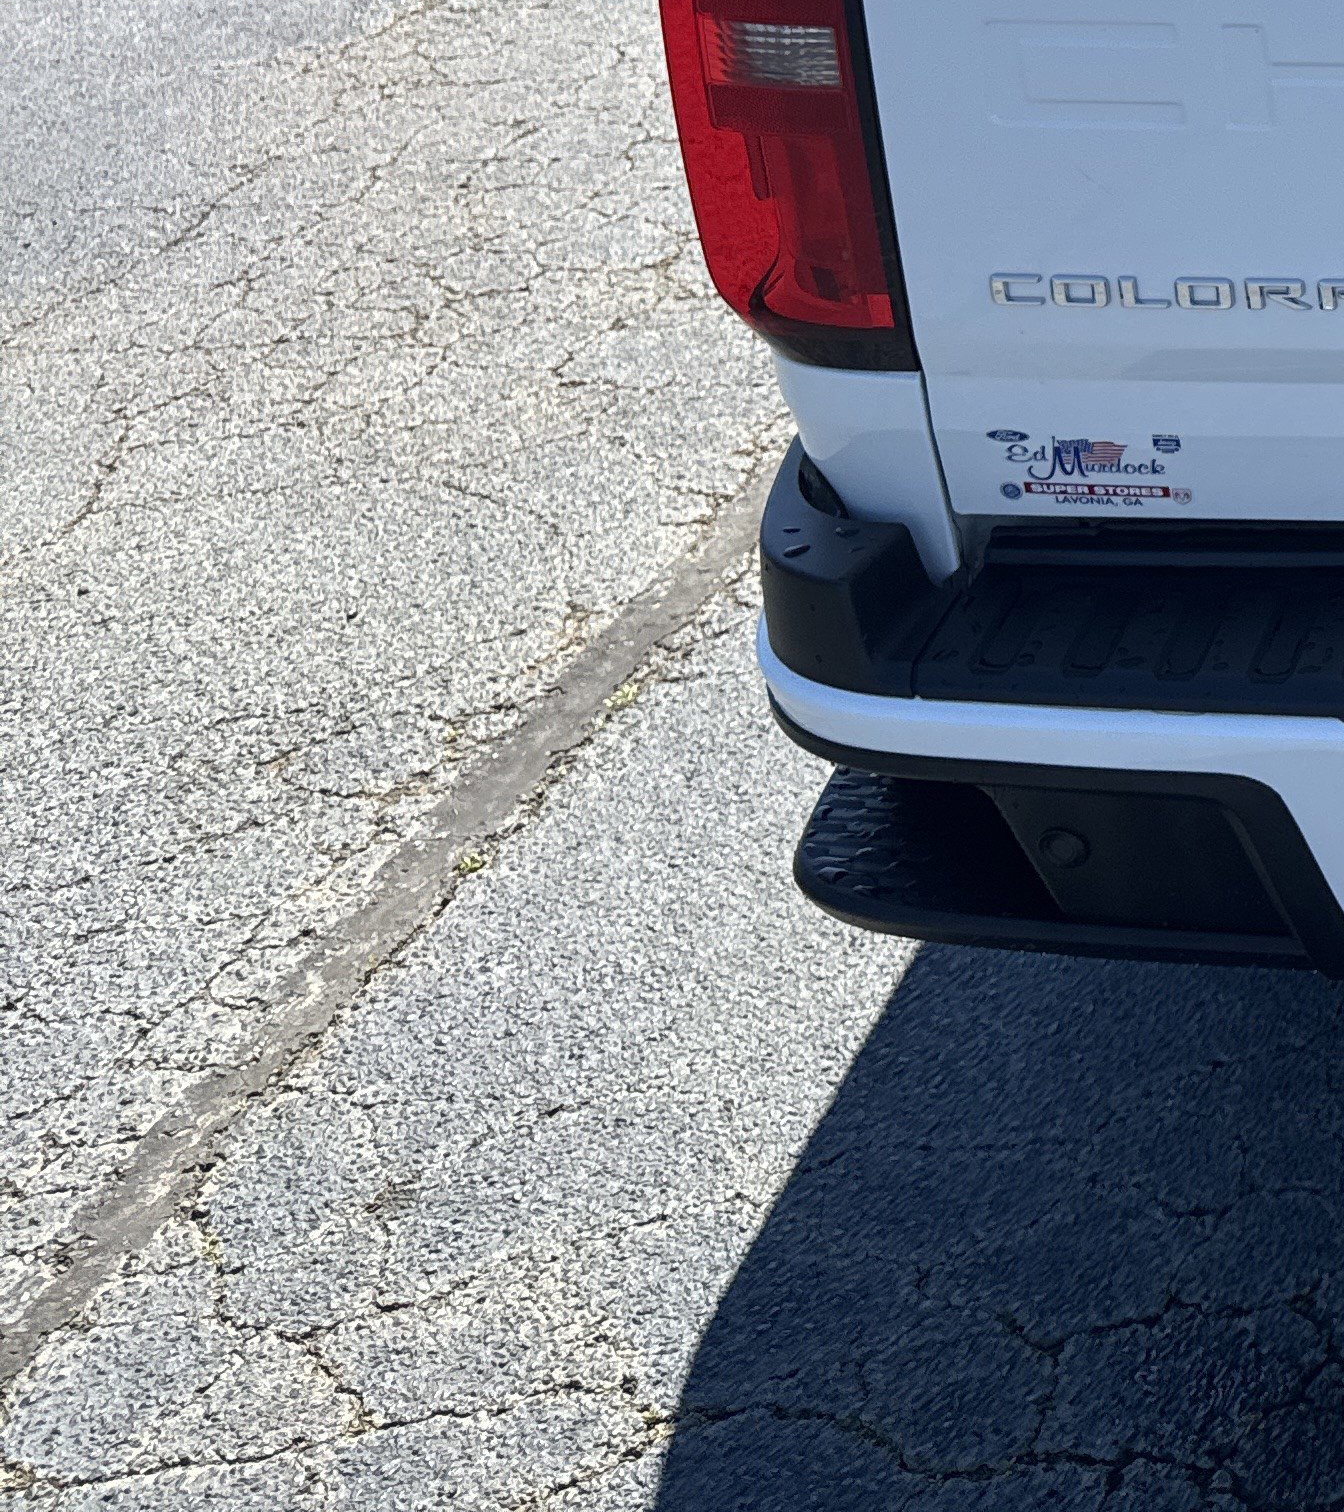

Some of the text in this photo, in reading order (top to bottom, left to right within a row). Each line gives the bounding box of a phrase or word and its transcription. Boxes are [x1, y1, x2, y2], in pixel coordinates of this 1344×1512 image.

[1006, 443, 1166, 480] Ed Murdock
[1030, 483, 1164, 497] SUPER STORES
[1055, 495, 1143, 507] LAVONIA, GA
